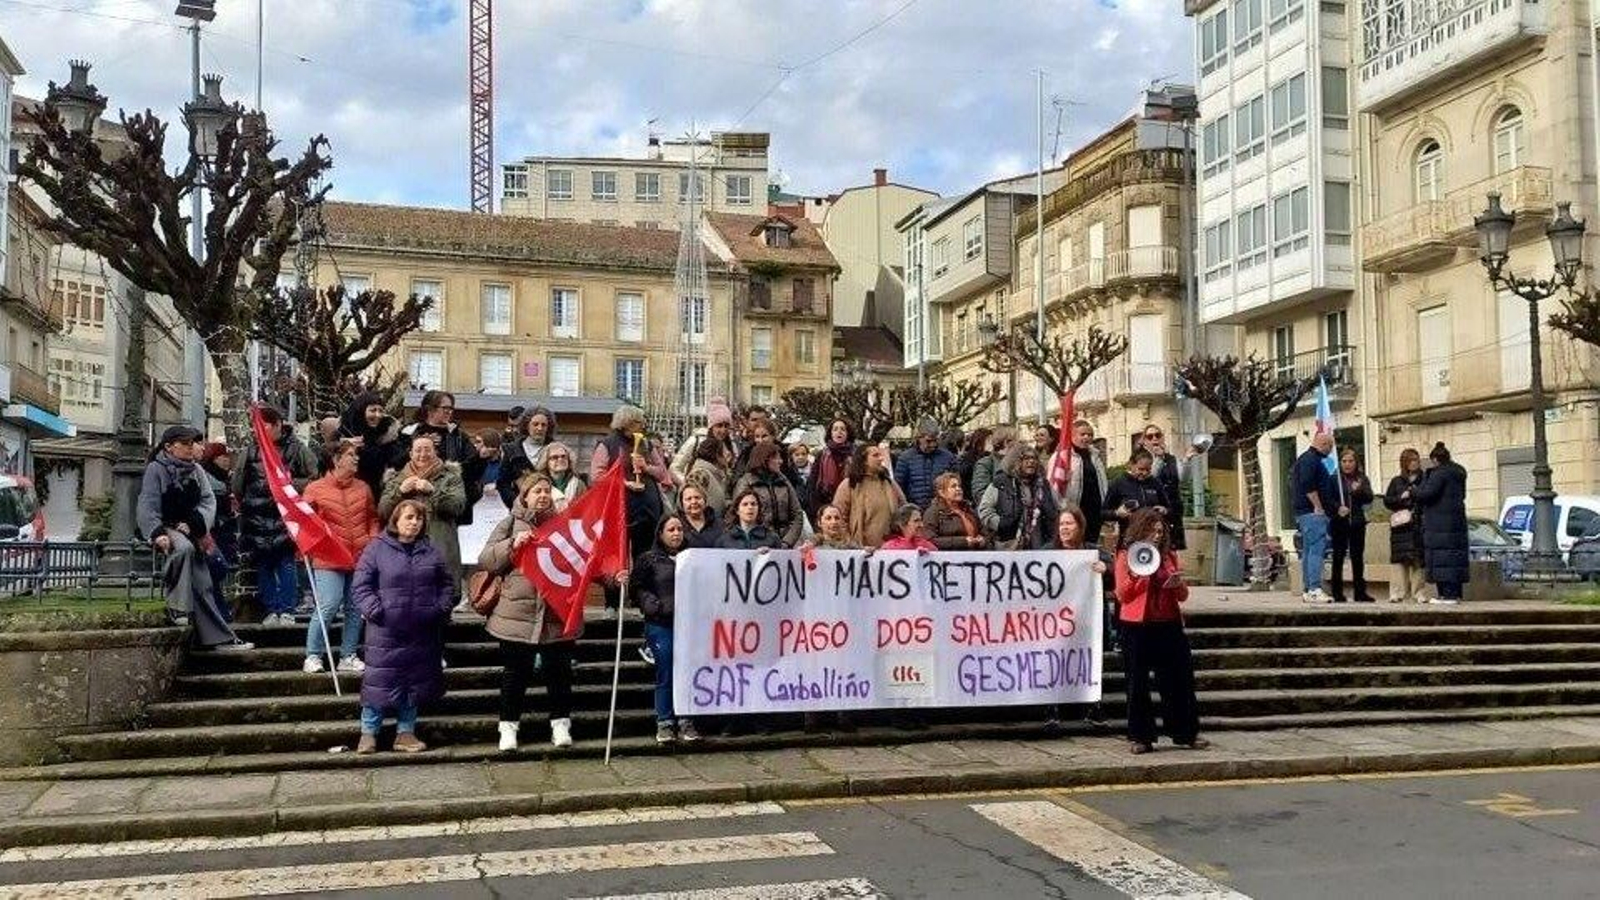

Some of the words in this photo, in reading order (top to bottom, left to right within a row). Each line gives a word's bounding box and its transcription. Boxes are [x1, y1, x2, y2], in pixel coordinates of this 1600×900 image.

[724, 558, 806, 606] NON
[922, 560, 1066, 604] RETRASO
[713, 618, 761, 659] NO
[779, 618, 849, 657] PAGO
[877, 616, 934, 649] DOS
[692, 662, 754, 707] SAF
[892, 665, 921, 682] CIG
[957, 646, 1099, 697] GESMEDICAL
